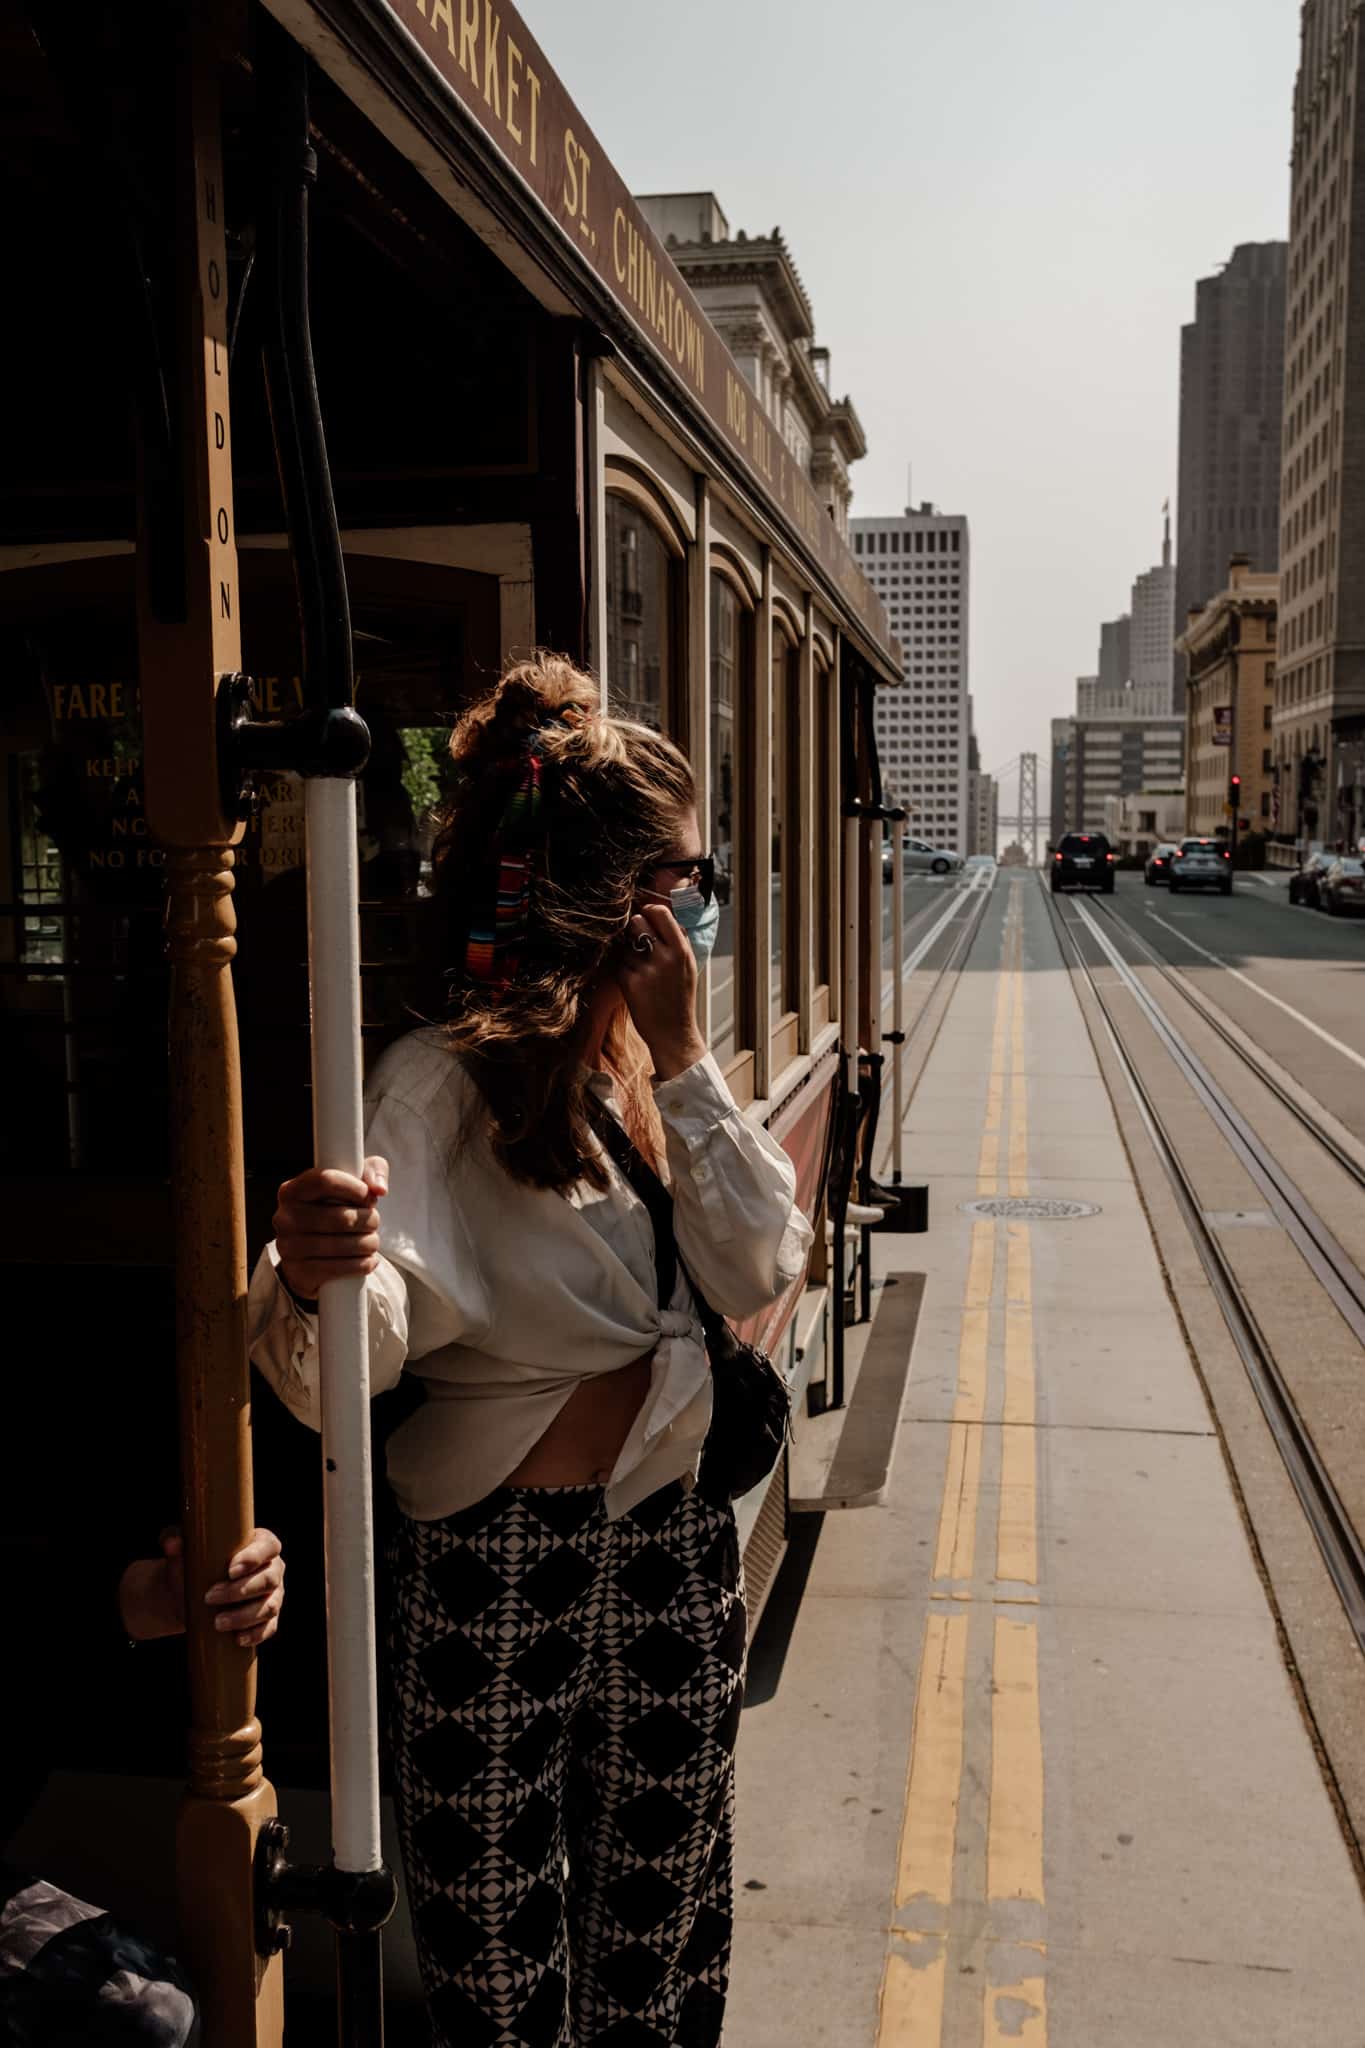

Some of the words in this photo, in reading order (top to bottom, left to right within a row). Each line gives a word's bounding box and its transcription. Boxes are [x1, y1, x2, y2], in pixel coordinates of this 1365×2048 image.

[416, 0, 541, 167] ARKET
[613, 207, 705, 394] CHINATOWN
[727, 369, 747, 446] NOB
[753, 410, 773, 484] HILL
[205, 174, 225, 450] HOLD
[217, 507, 231, 619] ON
[53, 680, 126, 721] FARE
[88, 848, 126, 870] NO
